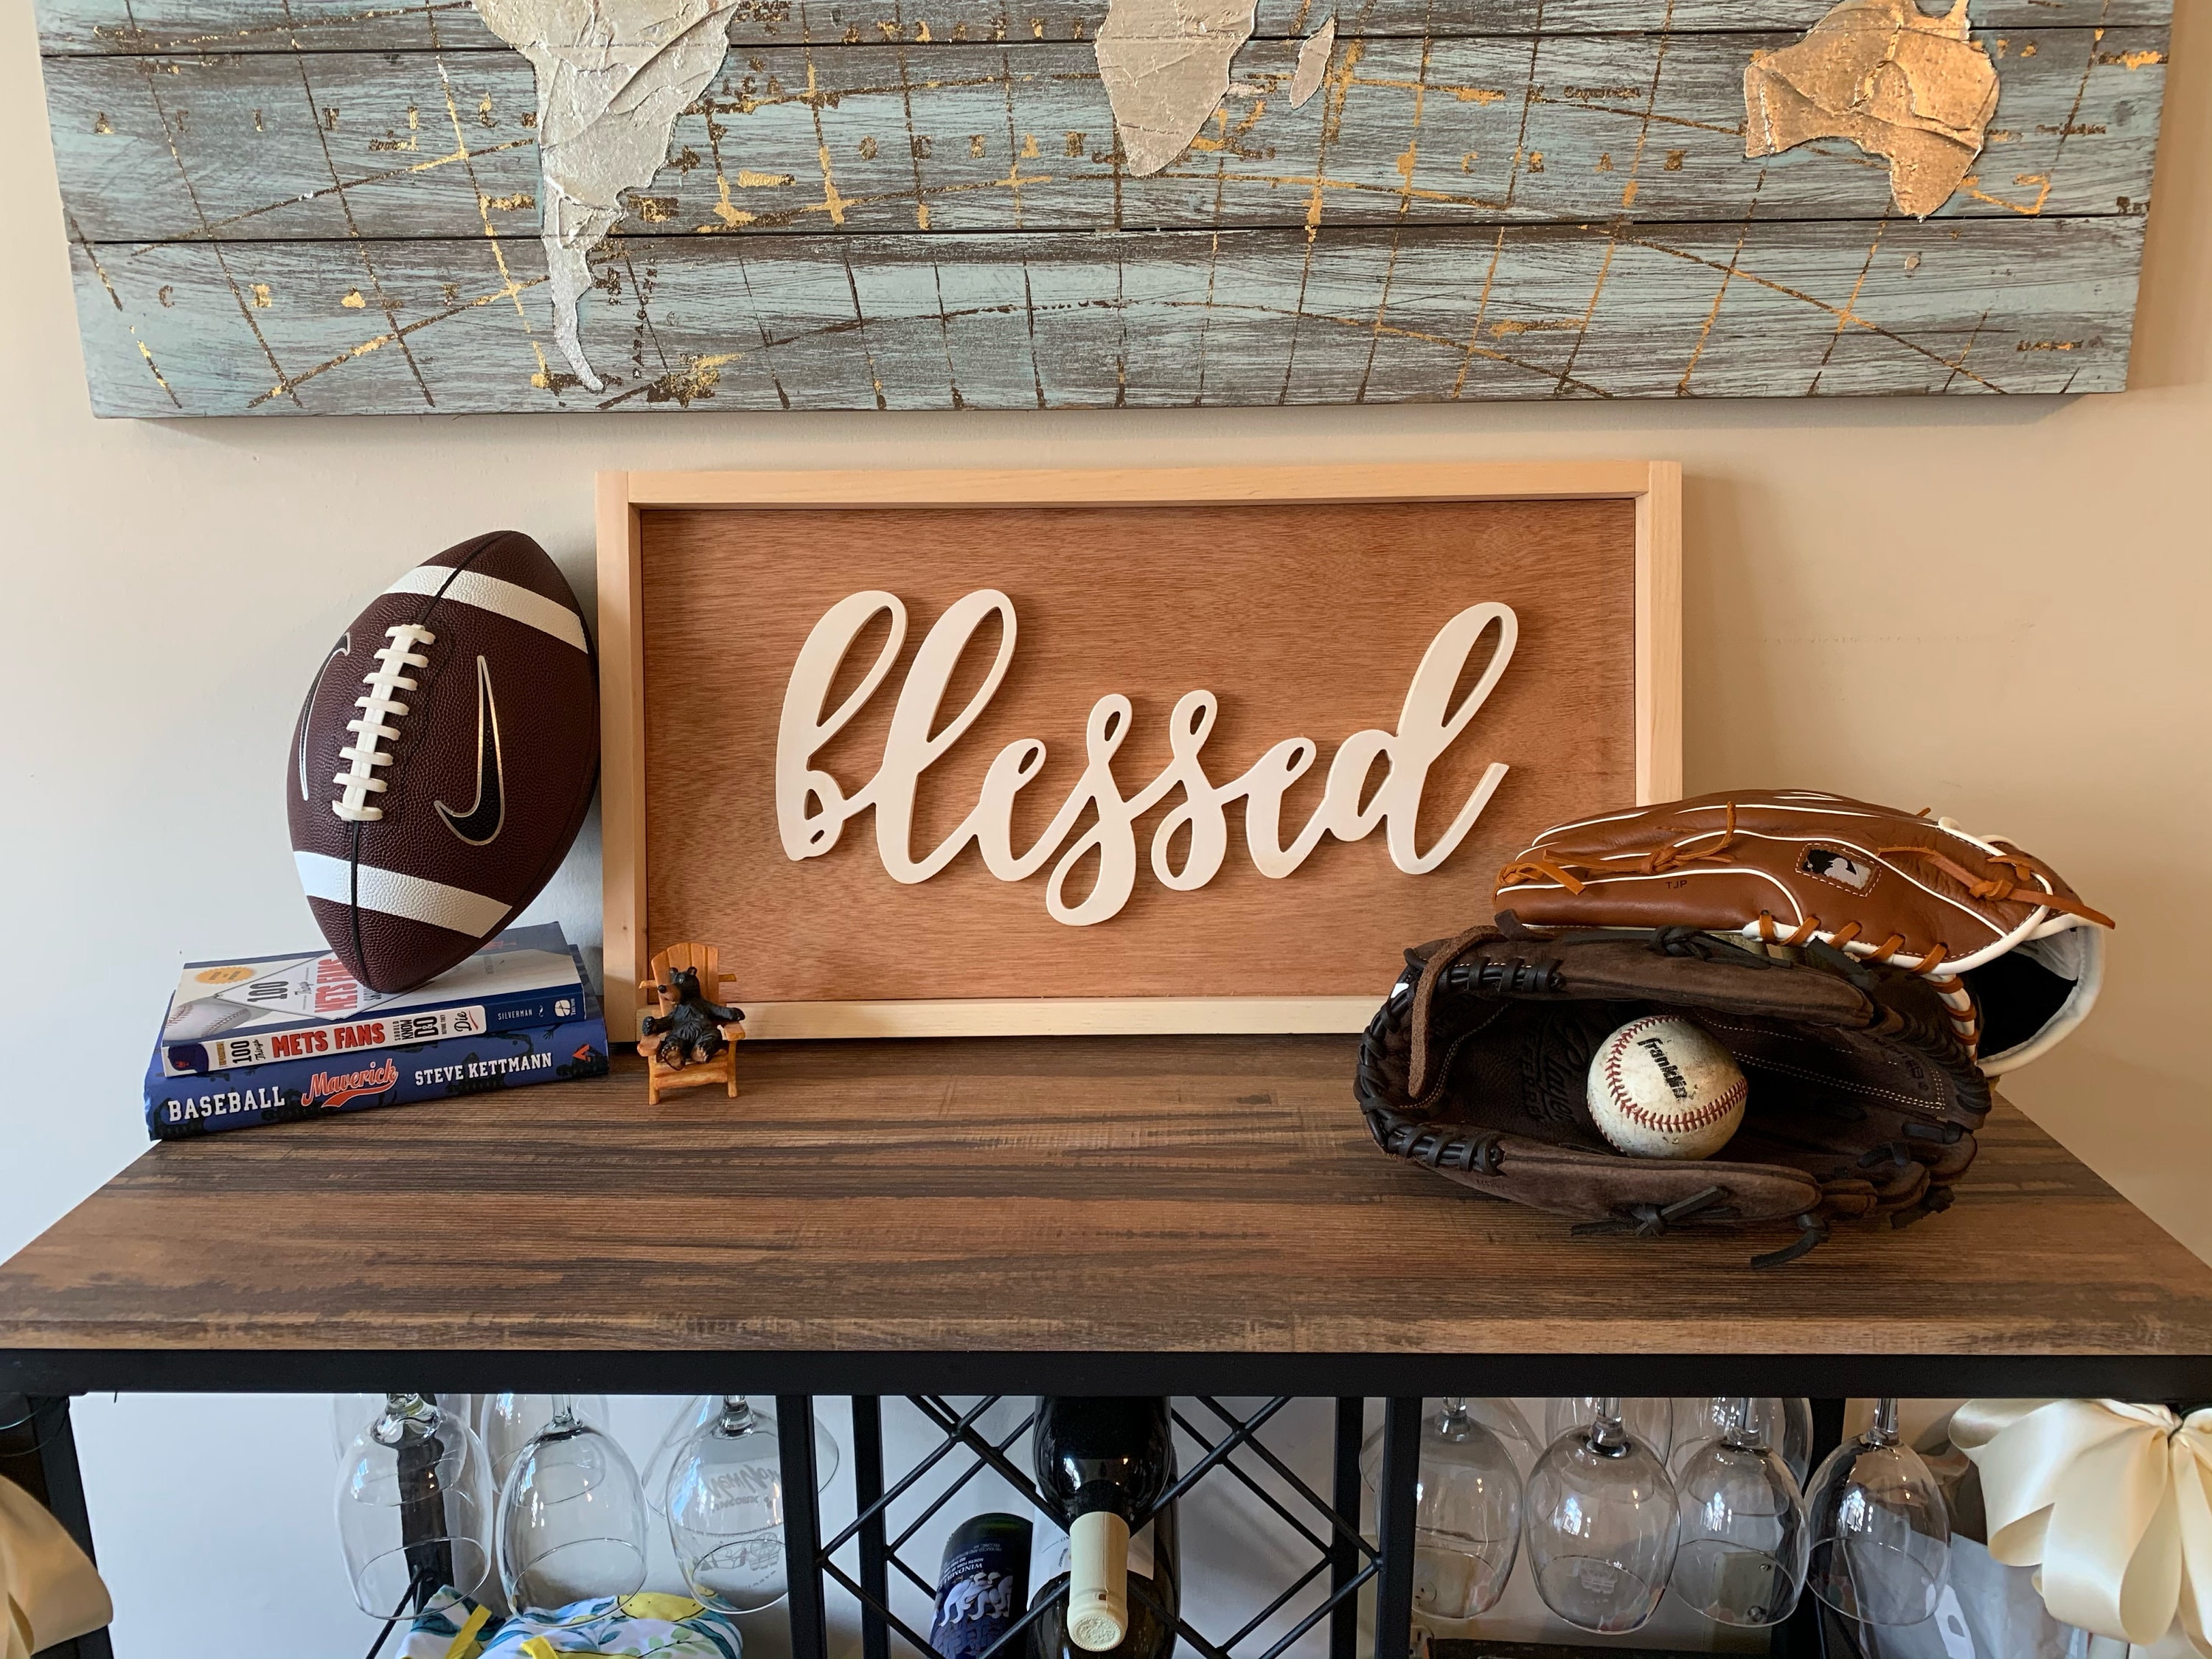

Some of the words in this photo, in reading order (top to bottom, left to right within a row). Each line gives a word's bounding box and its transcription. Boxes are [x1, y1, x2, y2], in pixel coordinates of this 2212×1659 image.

[775, 589, 1518, 926] blessed
[1665, 880, 1688, 889] TJP
[247, 981, 289, 1002] 100
[314, 983, 358, 1013] METS
[454, 1011, 473, 1032] Die
[497, 1009, 533, 1020] SILVERMAN
[271, 1032, 329, 1058] METS
[334, 1023, 386, 1049] FANS
[392, 1020, 402, 1041] SHOULD
[400, 1019, 414, 1040] KNOW
[230, 1040, 252, 1063] 100
[253, 1039, 266, 1061] Things
[415, 1065, 464, 1086] STEVE
[468, 1052, 552, 1079] KETTMANN
[1637, 1037, 1688, 1099] Franklin
[301, 1058, 399, 1107] Maverick
[168, 1086, 285, 1121] BASEBALL
